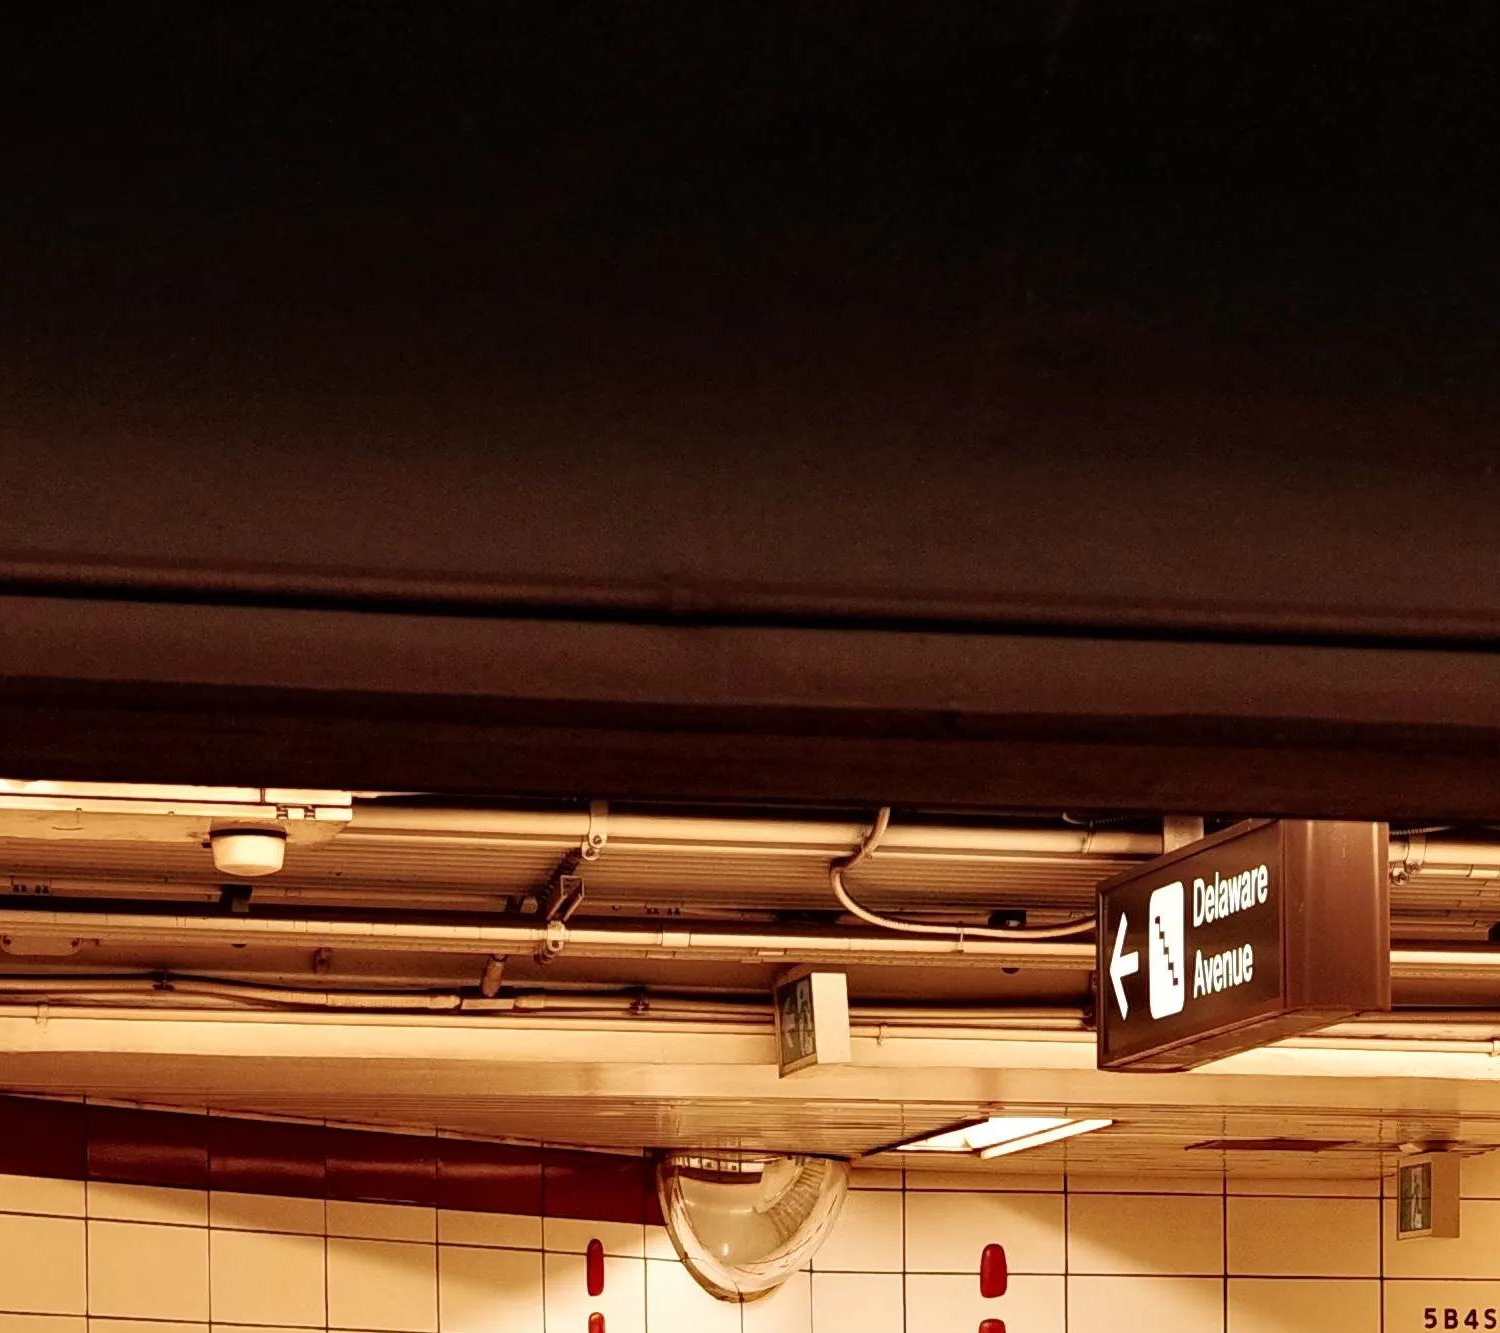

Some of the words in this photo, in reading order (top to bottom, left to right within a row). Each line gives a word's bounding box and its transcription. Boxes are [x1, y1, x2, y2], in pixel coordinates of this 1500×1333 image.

[1192, 864, 1269, 928] Delaware
[1192, 943, 1254, 1000] Avenue
[1423, 1307, 1498, 1330] 5B4S
